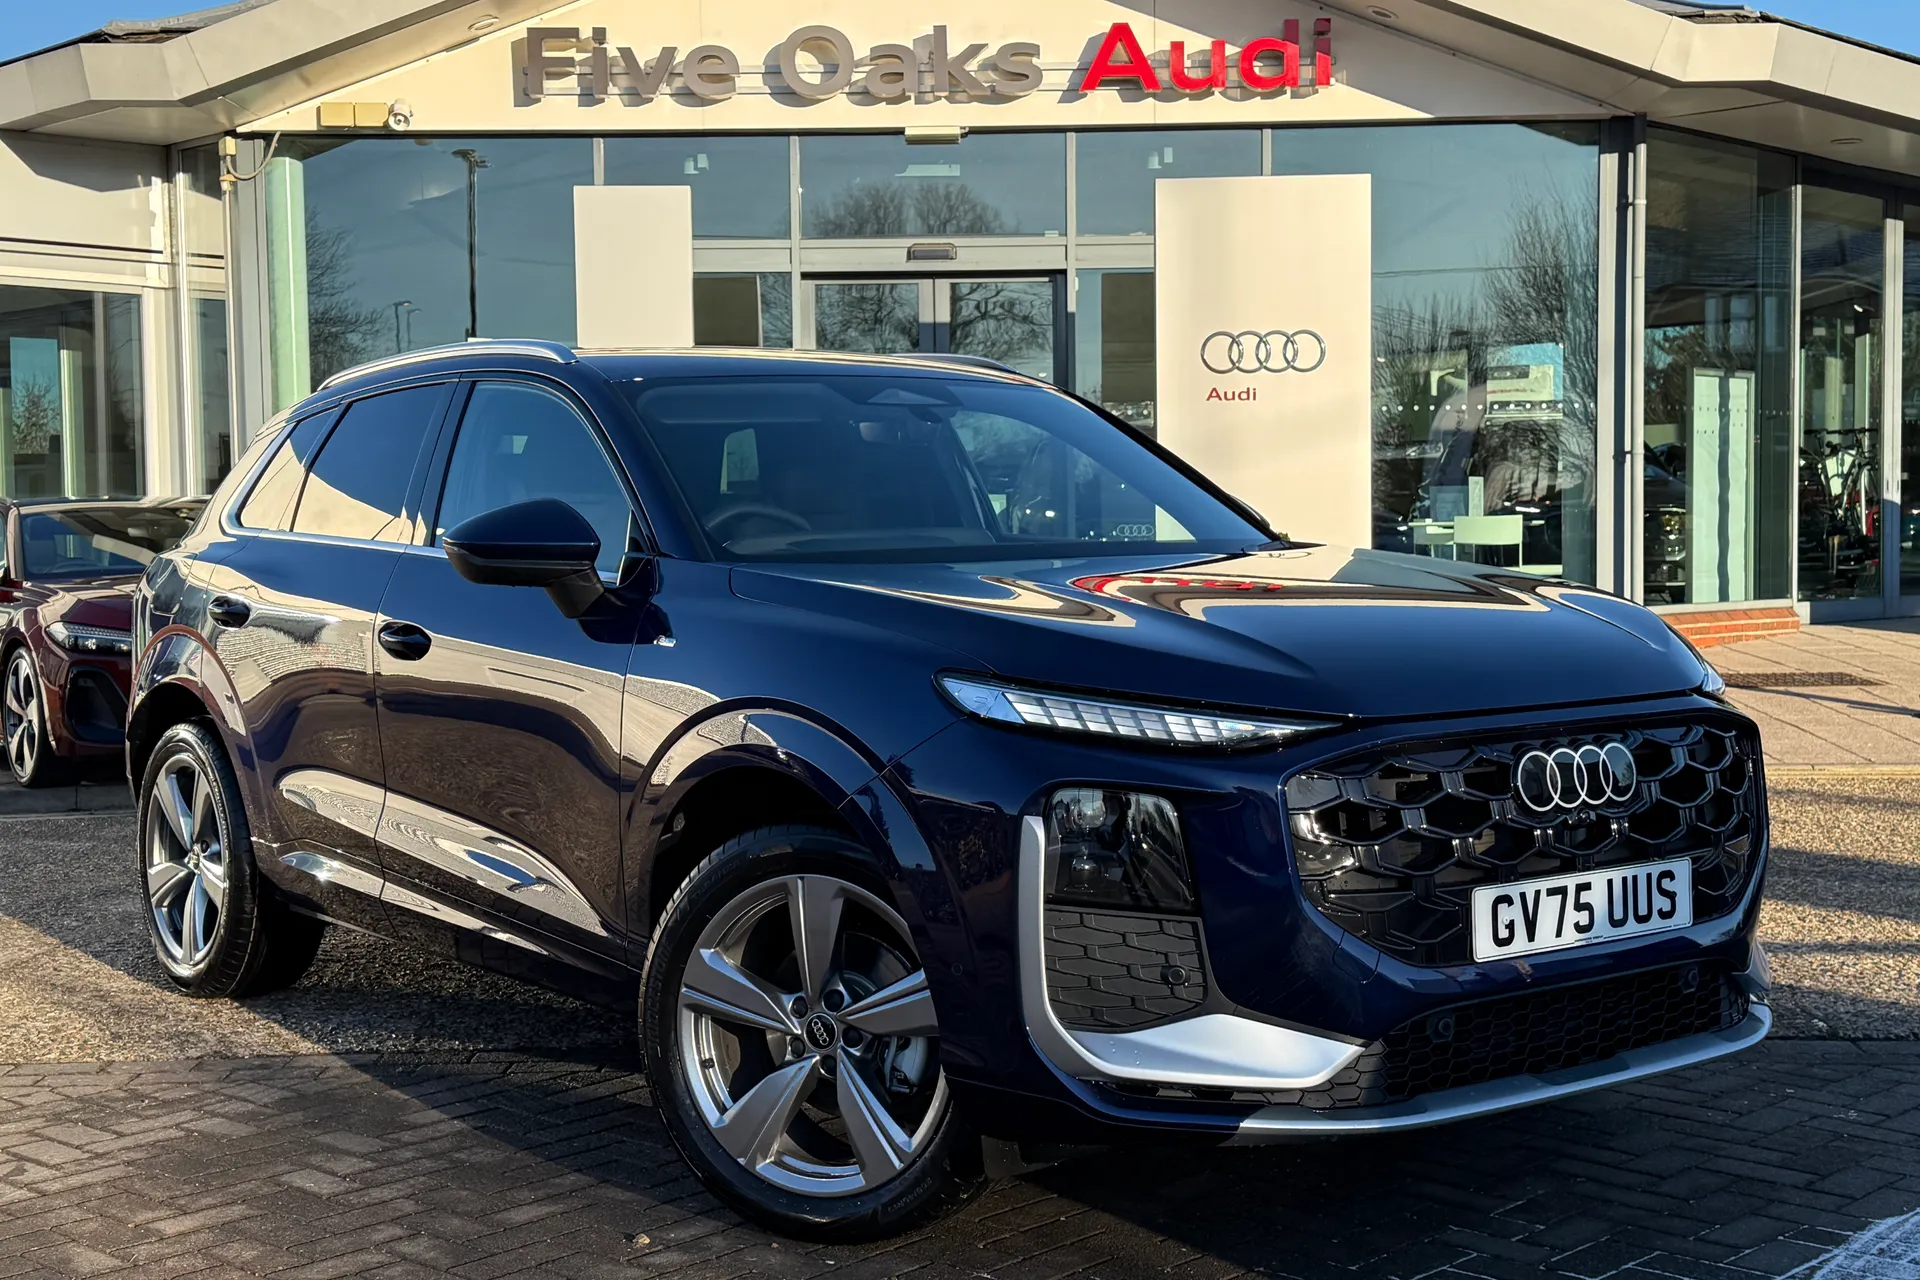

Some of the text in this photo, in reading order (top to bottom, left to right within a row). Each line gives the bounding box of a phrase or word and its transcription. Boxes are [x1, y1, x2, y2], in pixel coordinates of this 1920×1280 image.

[526, 17, 1333, 100] Five Oaks Audi
[1205, 386, 1258, 402] Audi
[1490, 868, 1678, 948] GV75 UUS
